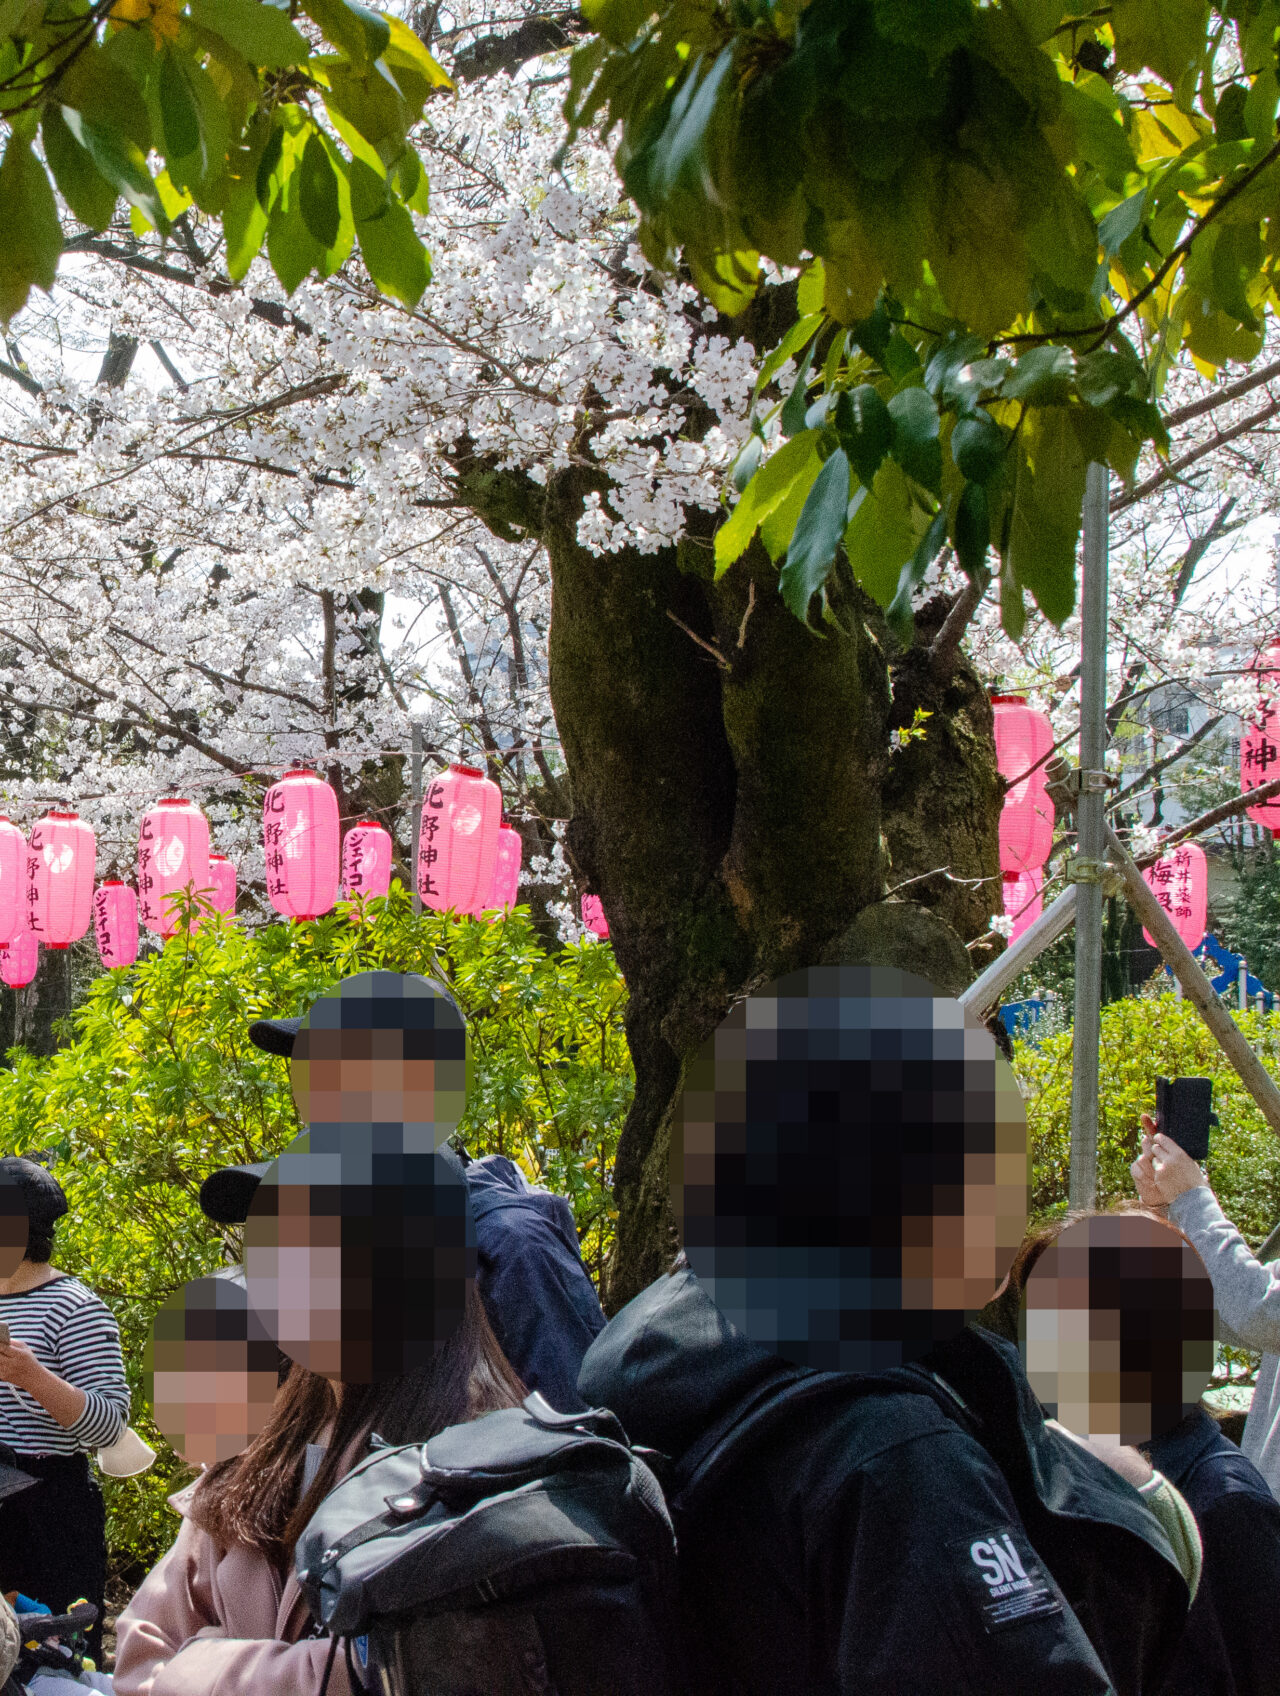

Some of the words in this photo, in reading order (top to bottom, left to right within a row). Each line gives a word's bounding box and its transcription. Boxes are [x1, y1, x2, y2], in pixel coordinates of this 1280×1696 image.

[264, 788, 289, 898] 北野神社
[418, 782, 444, 896] 北野神社
[1174, 850, 1193, 919] 新井薬師
[95, 890, 114, 957] ジェイコム
[970, 1533, 1028, 1586] SN
[989, 1582, 1014, 1598] SILENT
